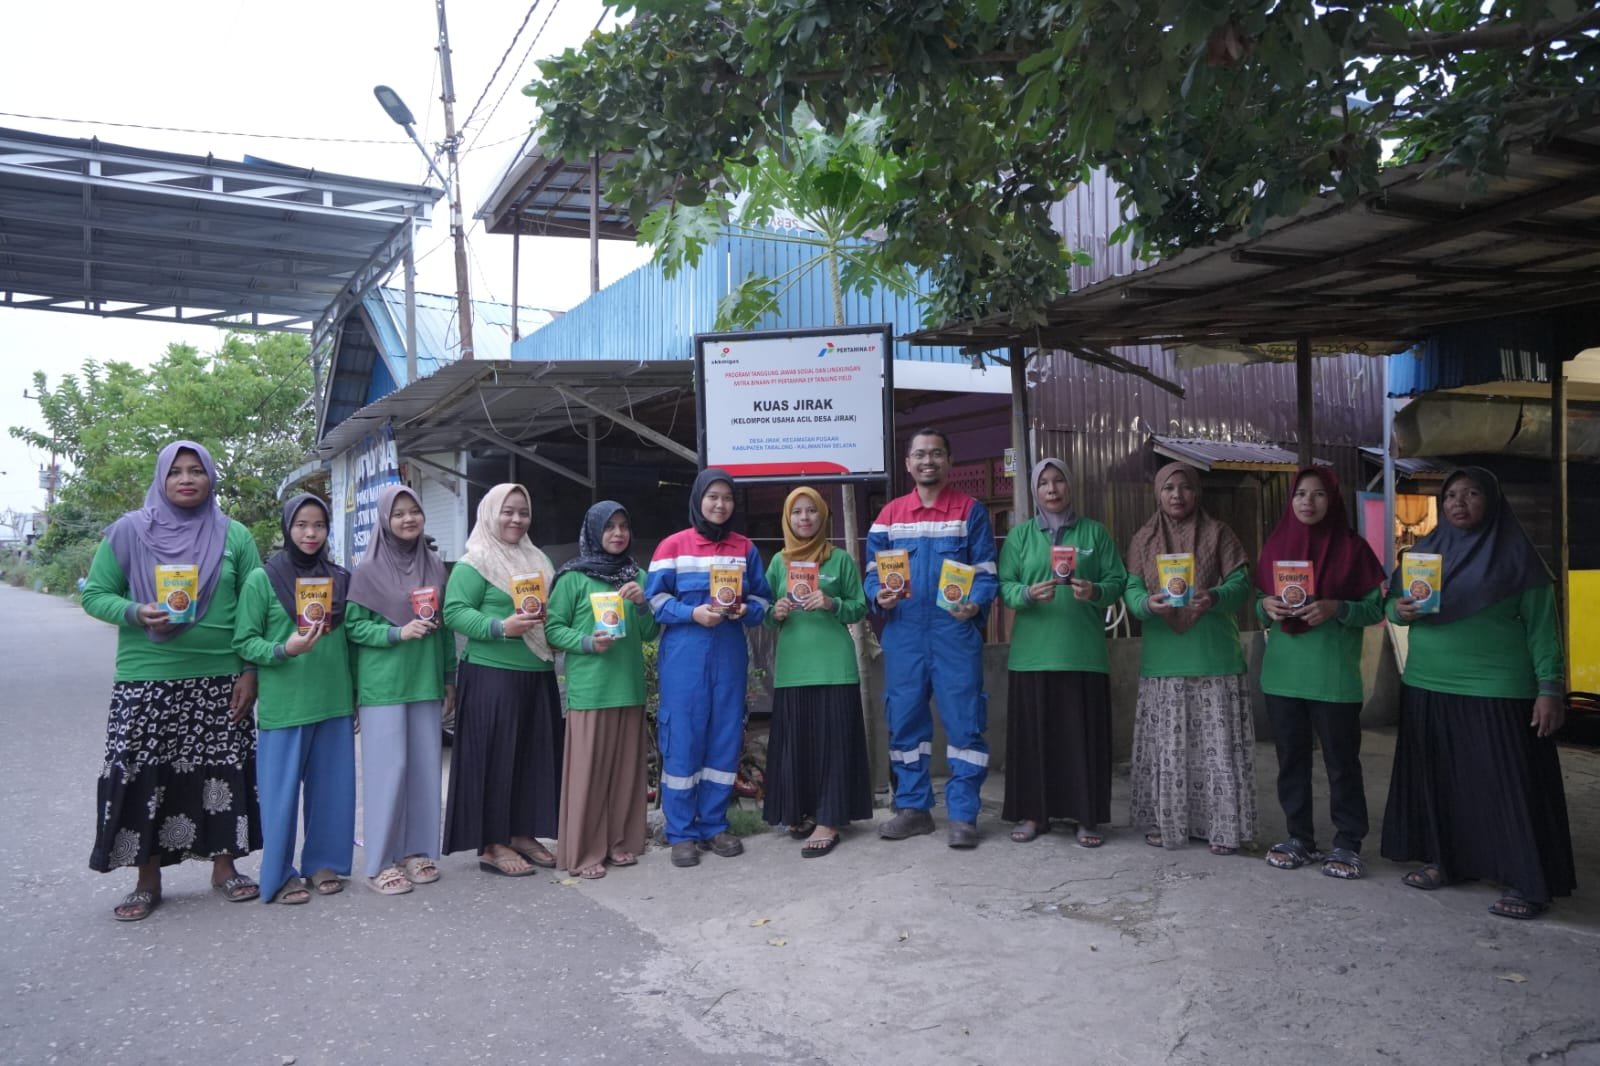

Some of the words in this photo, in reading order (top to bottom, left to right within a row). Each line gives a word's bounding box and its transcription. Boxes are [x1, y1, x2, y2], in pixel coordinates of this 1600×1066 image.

[778, 377, 806, 385] PERTAMINA
[753, 400, 789, 412] KUAS
[793, 398, 833, 411] JIRAK
[730, 417, 770, 426] (KELOMPOK
[771, 416, 795, 424] USAHA
[813, 415, 832, 423] DESA
[833, 414, 857, 423] JIRAK)
